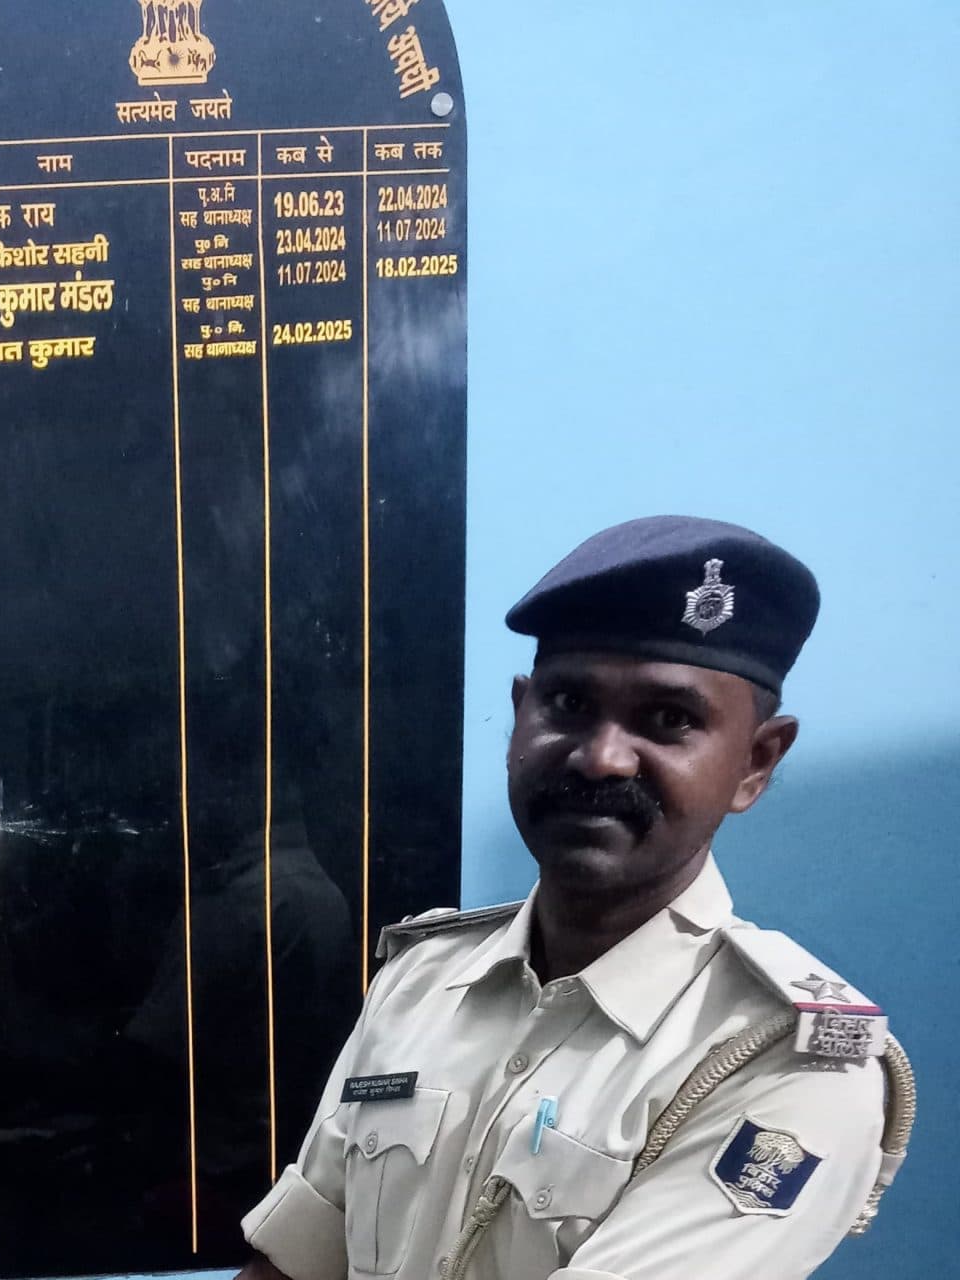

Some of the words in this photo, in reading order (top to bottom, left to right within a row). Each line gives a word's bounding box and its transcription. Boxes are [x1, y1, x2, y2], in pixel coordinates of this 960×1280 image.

[116, 94, 177, 123] सत्यमेव
[190, 89, 232, 119] जयते
[185, 150, 246, 170] पदनाम
[276, 147, 306, 163] कब
[316, 136, 333, 162] से
[375, 144, 404, 160] कब
[414, 142, 442, 159] तक
[37, 155, 72, 172] नाम
[274, 191, 344, 217] 19.06.23
[379, 184, 447, 211] 22.04.2024
[21, 204, 55, 227] राय
[179, 212, 197, 228] सह
[277, 226, 345, 254] 23.04.2024
[182, 258, 202, 269] सह
[376, 255, 457, 277] 18.02.2025
[60, 271, 114, 311] मंडल
[182, 299, 200, 313] सह
[273, 320, 352, 344] 24.02.2025
[28, 337, 96, 368] कुमार
[184, 344, 204, 358] सह
